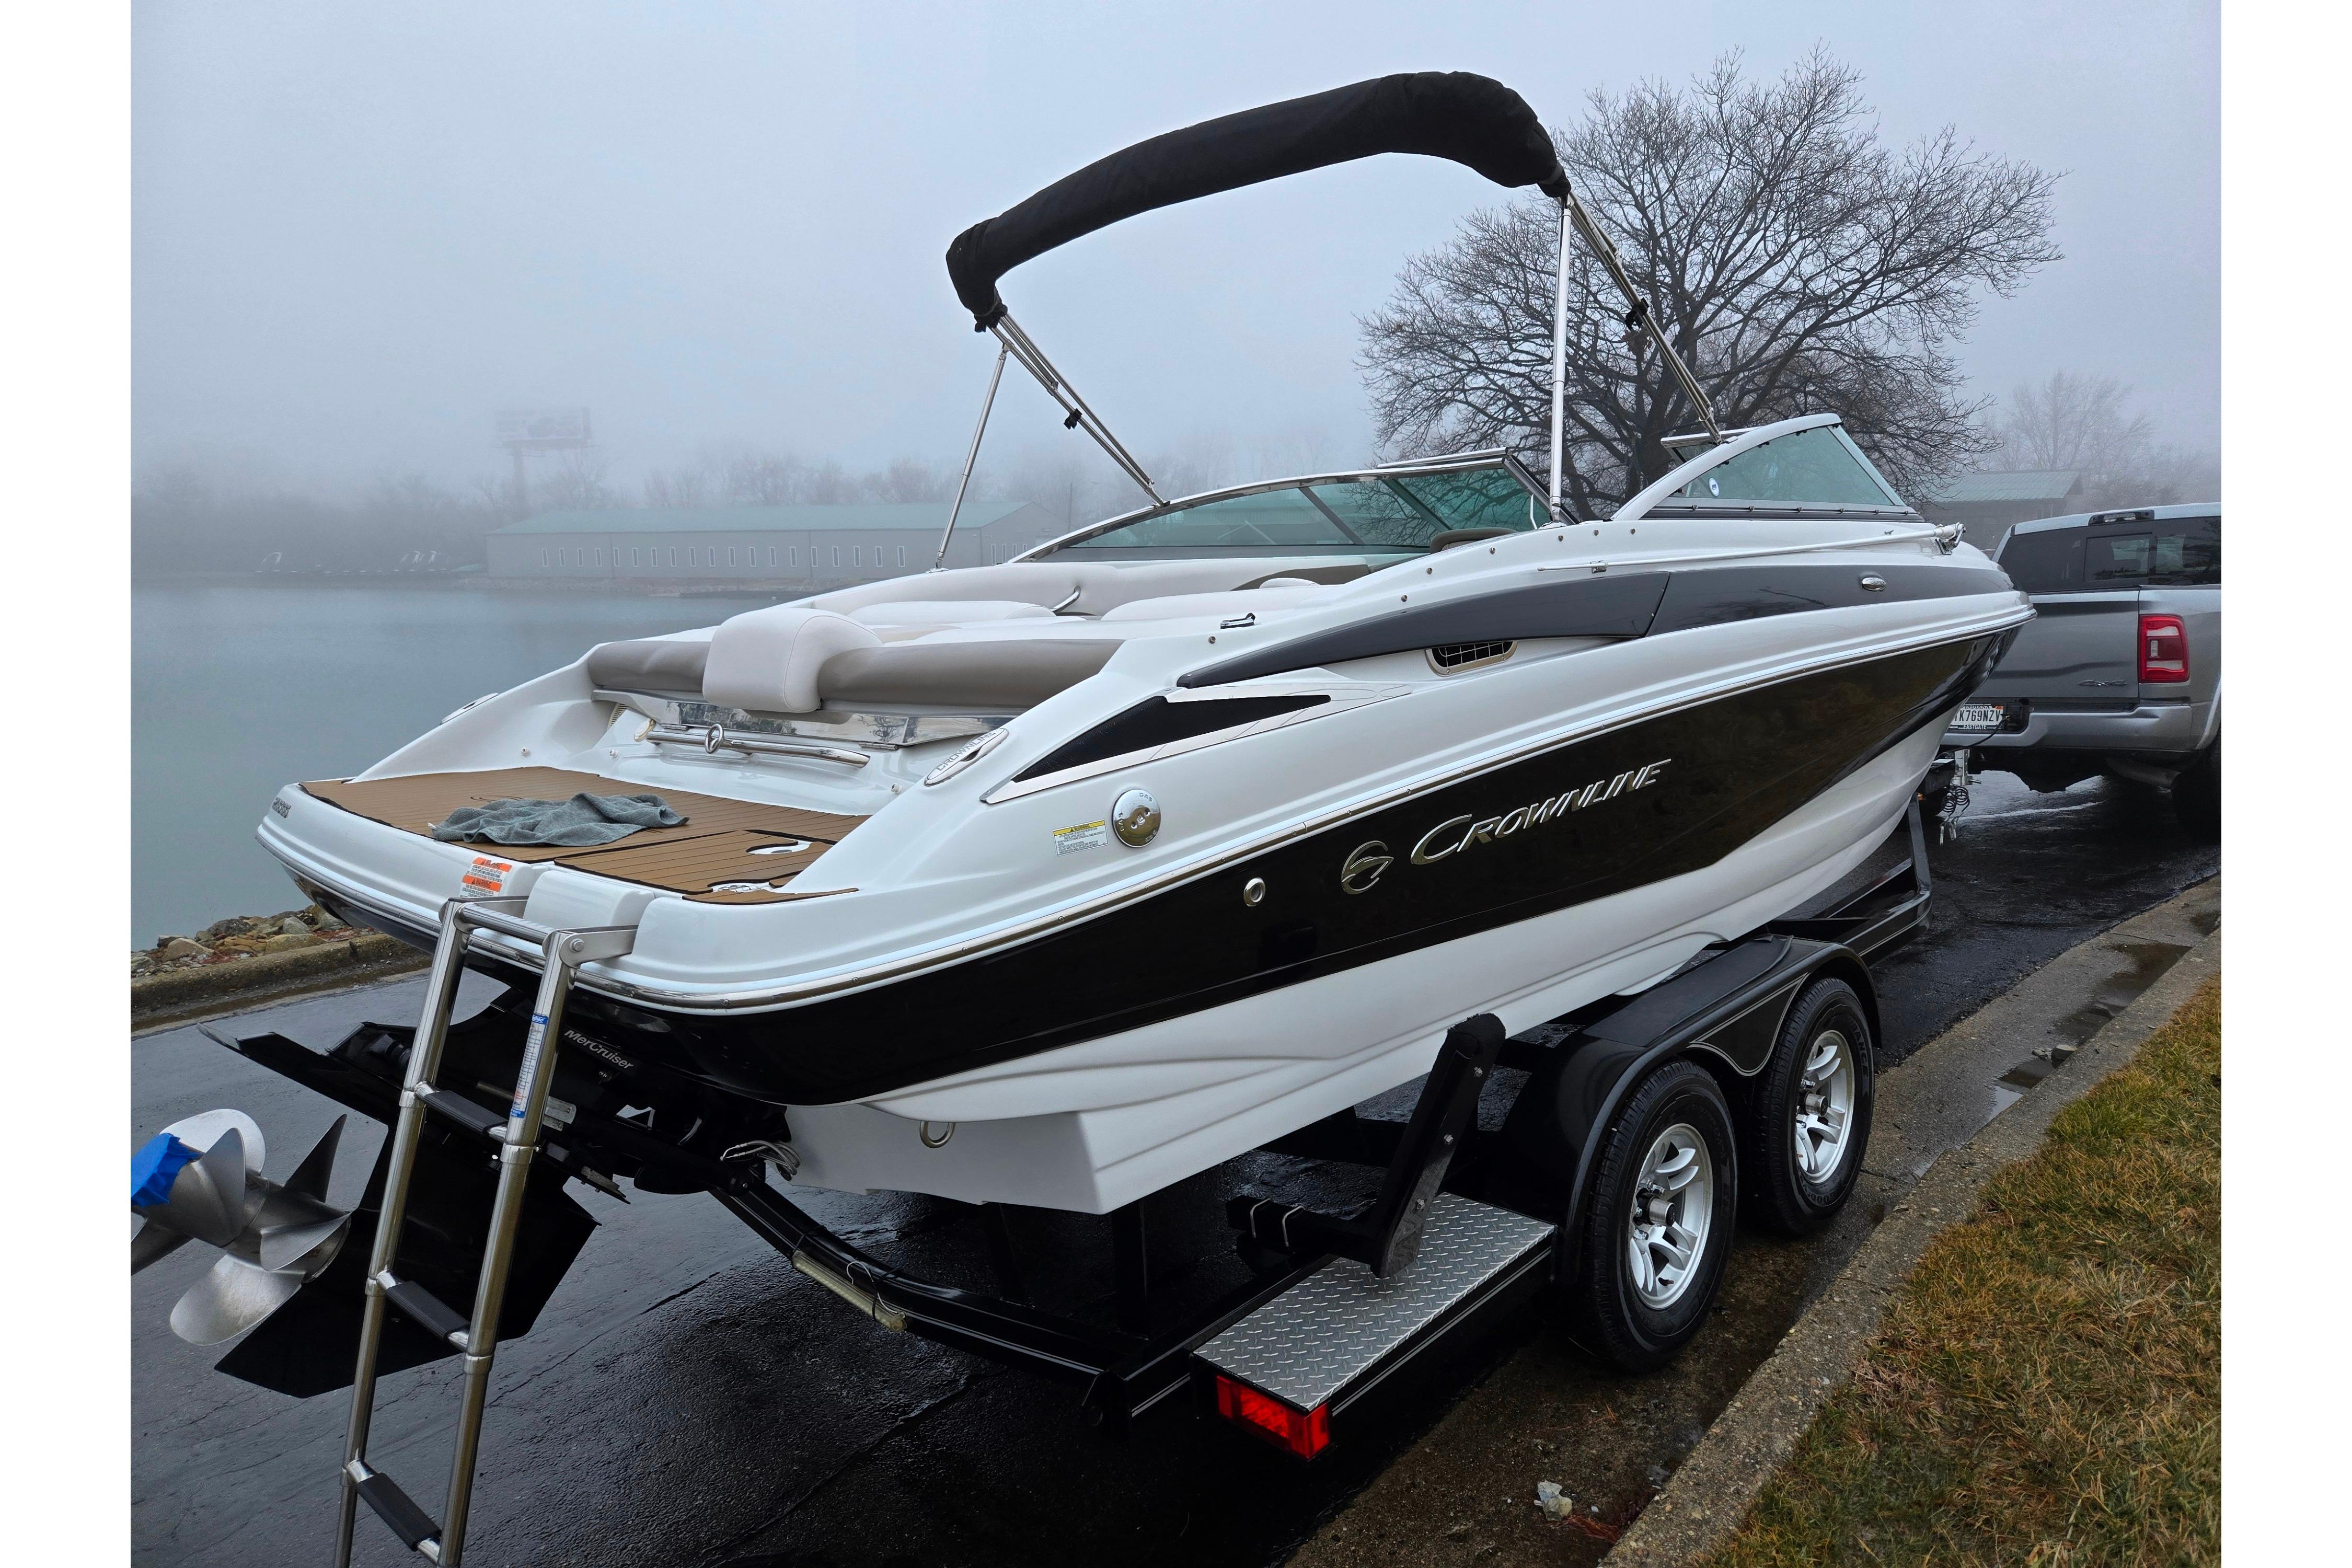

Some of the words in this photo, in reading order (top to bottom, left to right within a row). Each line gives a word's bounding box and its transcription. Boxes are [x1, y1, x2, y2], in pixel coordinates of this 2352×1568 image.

[936, 732, 996, 771] CROWNLINE
[1139, 792, 1152, 802] GAS
[1411, 758, 1671, 865] CROWNLINE
[564, 1030, 634, 1068] MerCruiser
